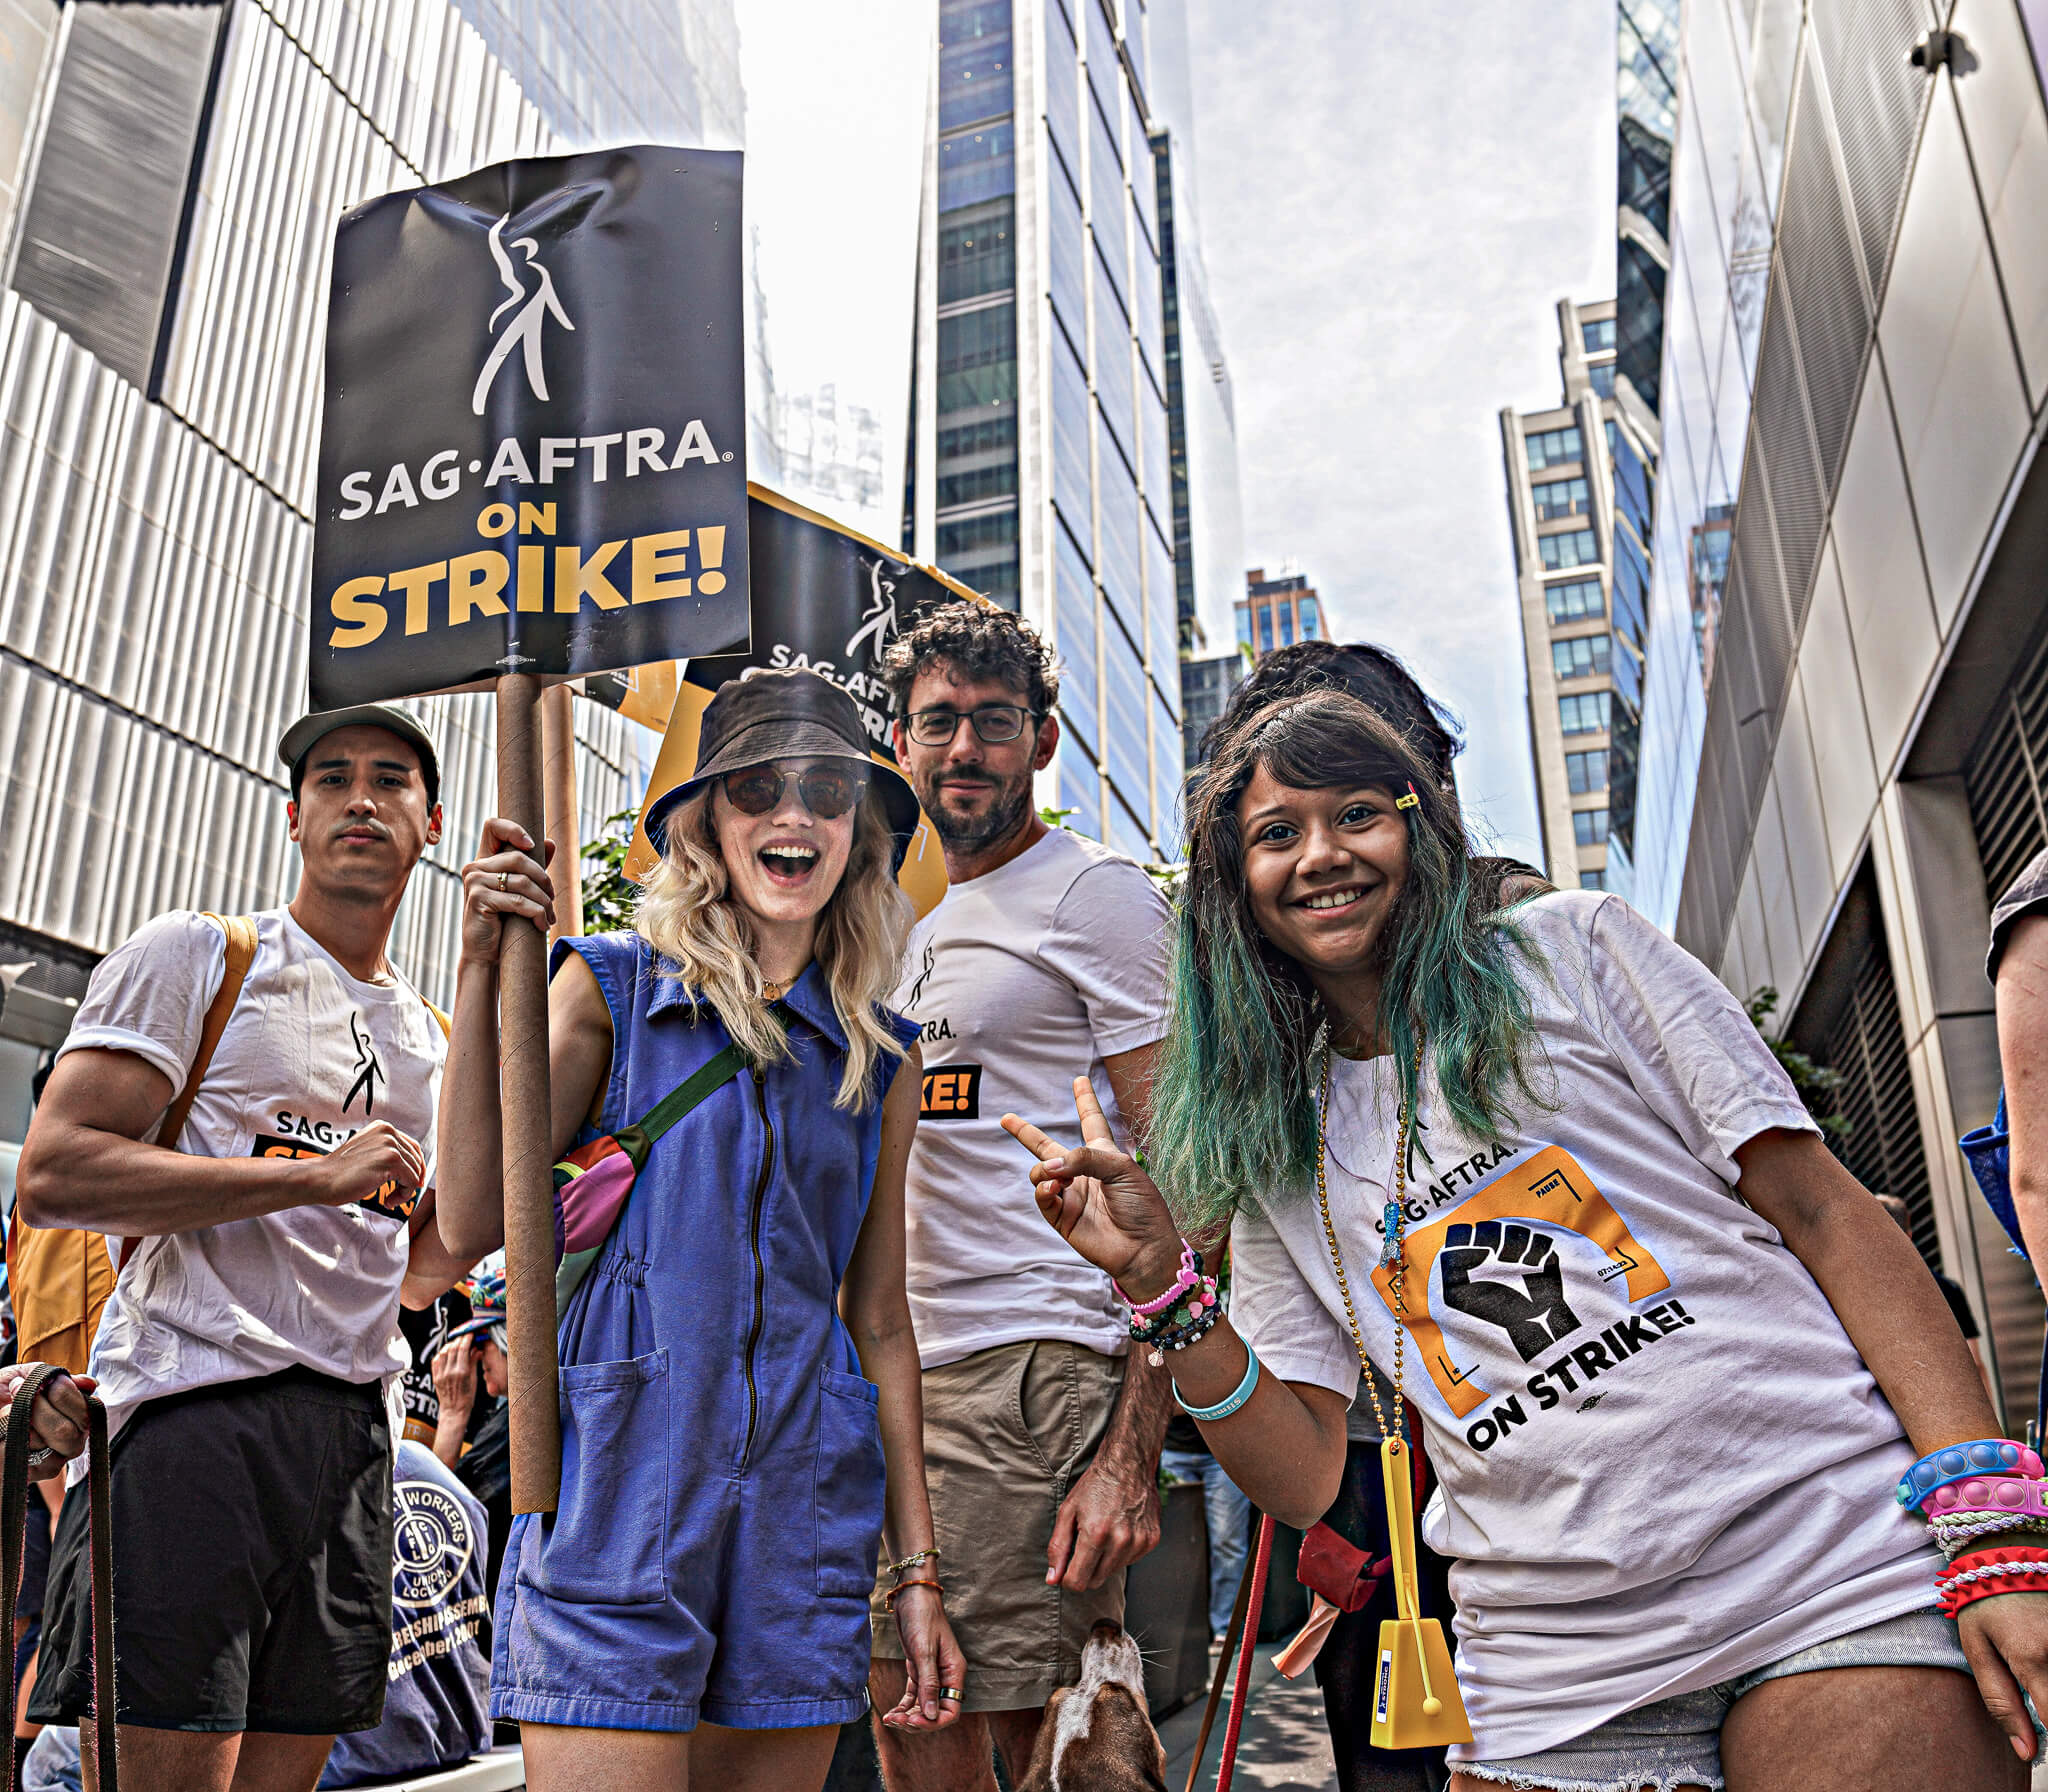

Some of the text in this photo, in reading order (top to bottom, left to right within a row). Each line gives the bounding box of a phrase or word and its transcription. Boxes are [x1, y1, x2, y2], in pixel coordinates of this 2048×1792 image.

[477, 502, 557, 539] ON
[329, 525, 727, 649] STRIKE!
[1526, 1298, 1696, 1411] STRIKE!
[1466, 1394, 1529, 1452] ON
[406, 1491, 465, 1543] WORKERS
